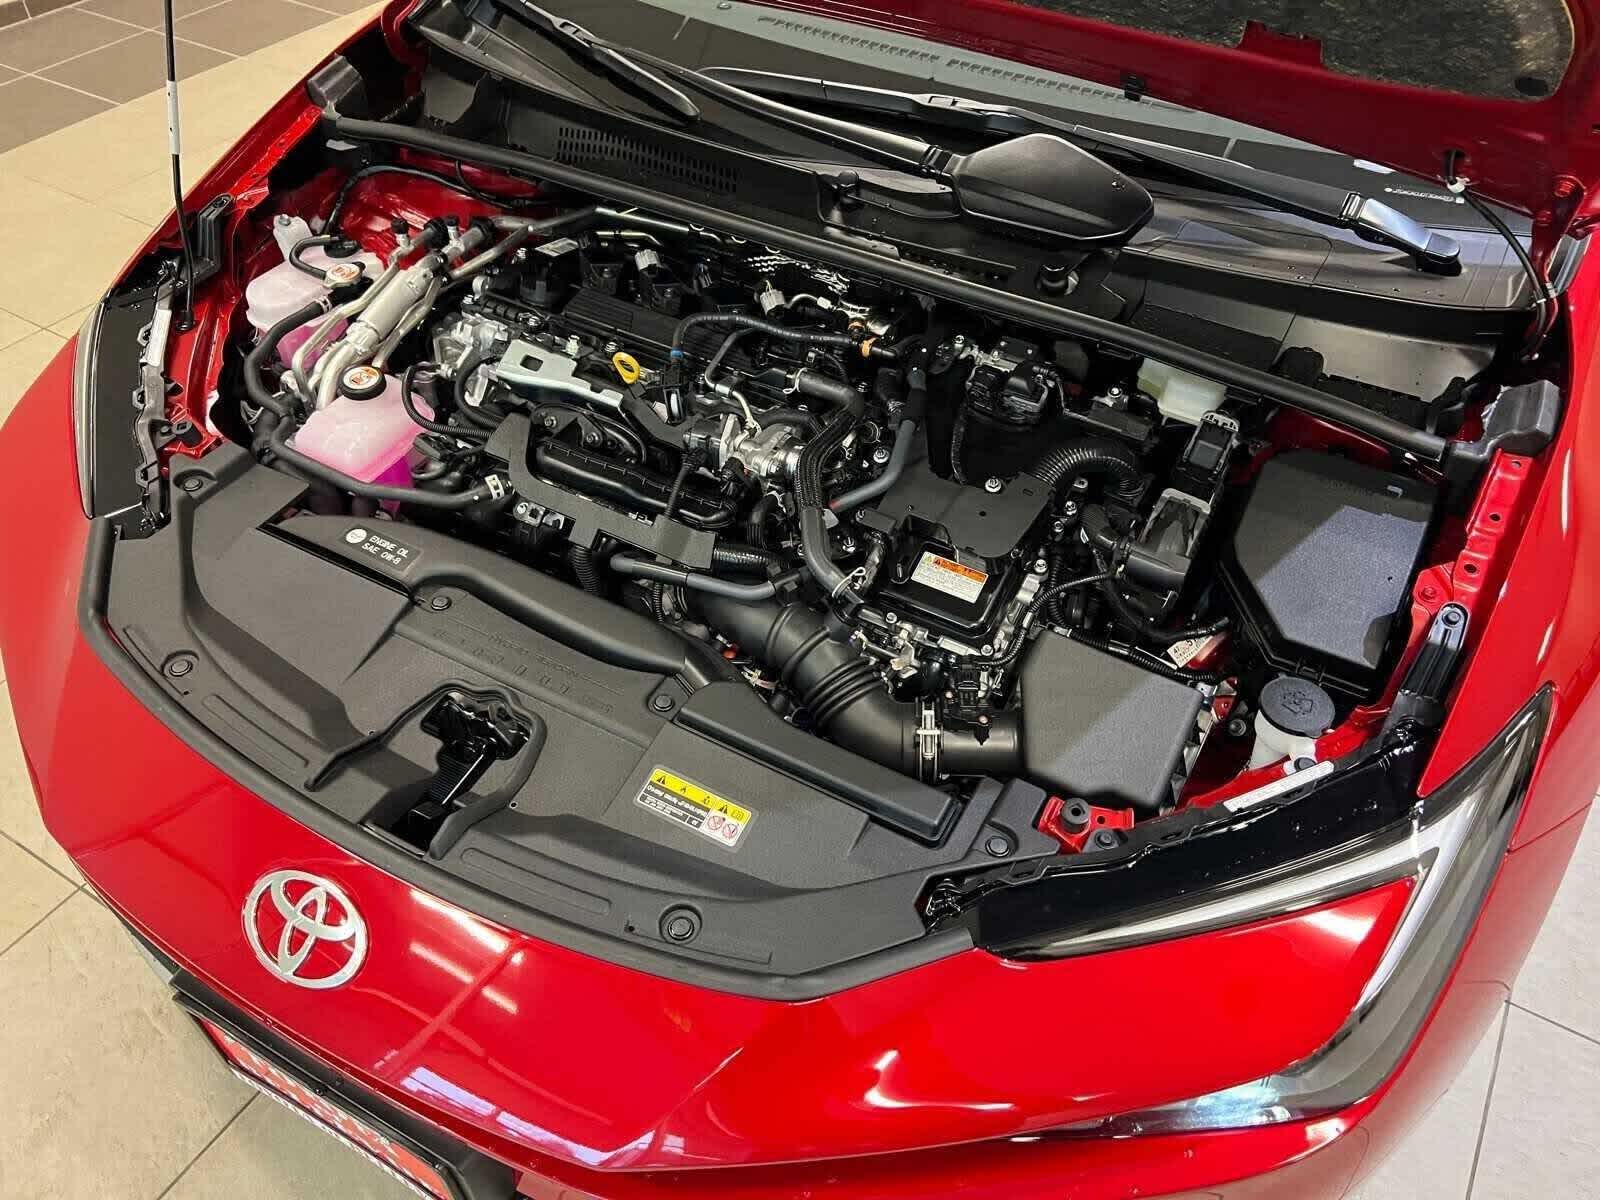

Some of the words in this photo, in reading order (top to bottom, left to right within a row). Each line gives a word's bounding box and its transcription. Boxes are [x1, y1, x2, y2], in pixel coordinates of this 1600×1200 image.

[361, 542, 380, 554] SAE
[369, 535, 397, 551] ENGINE
[397, 547, 409, 558] OIL
